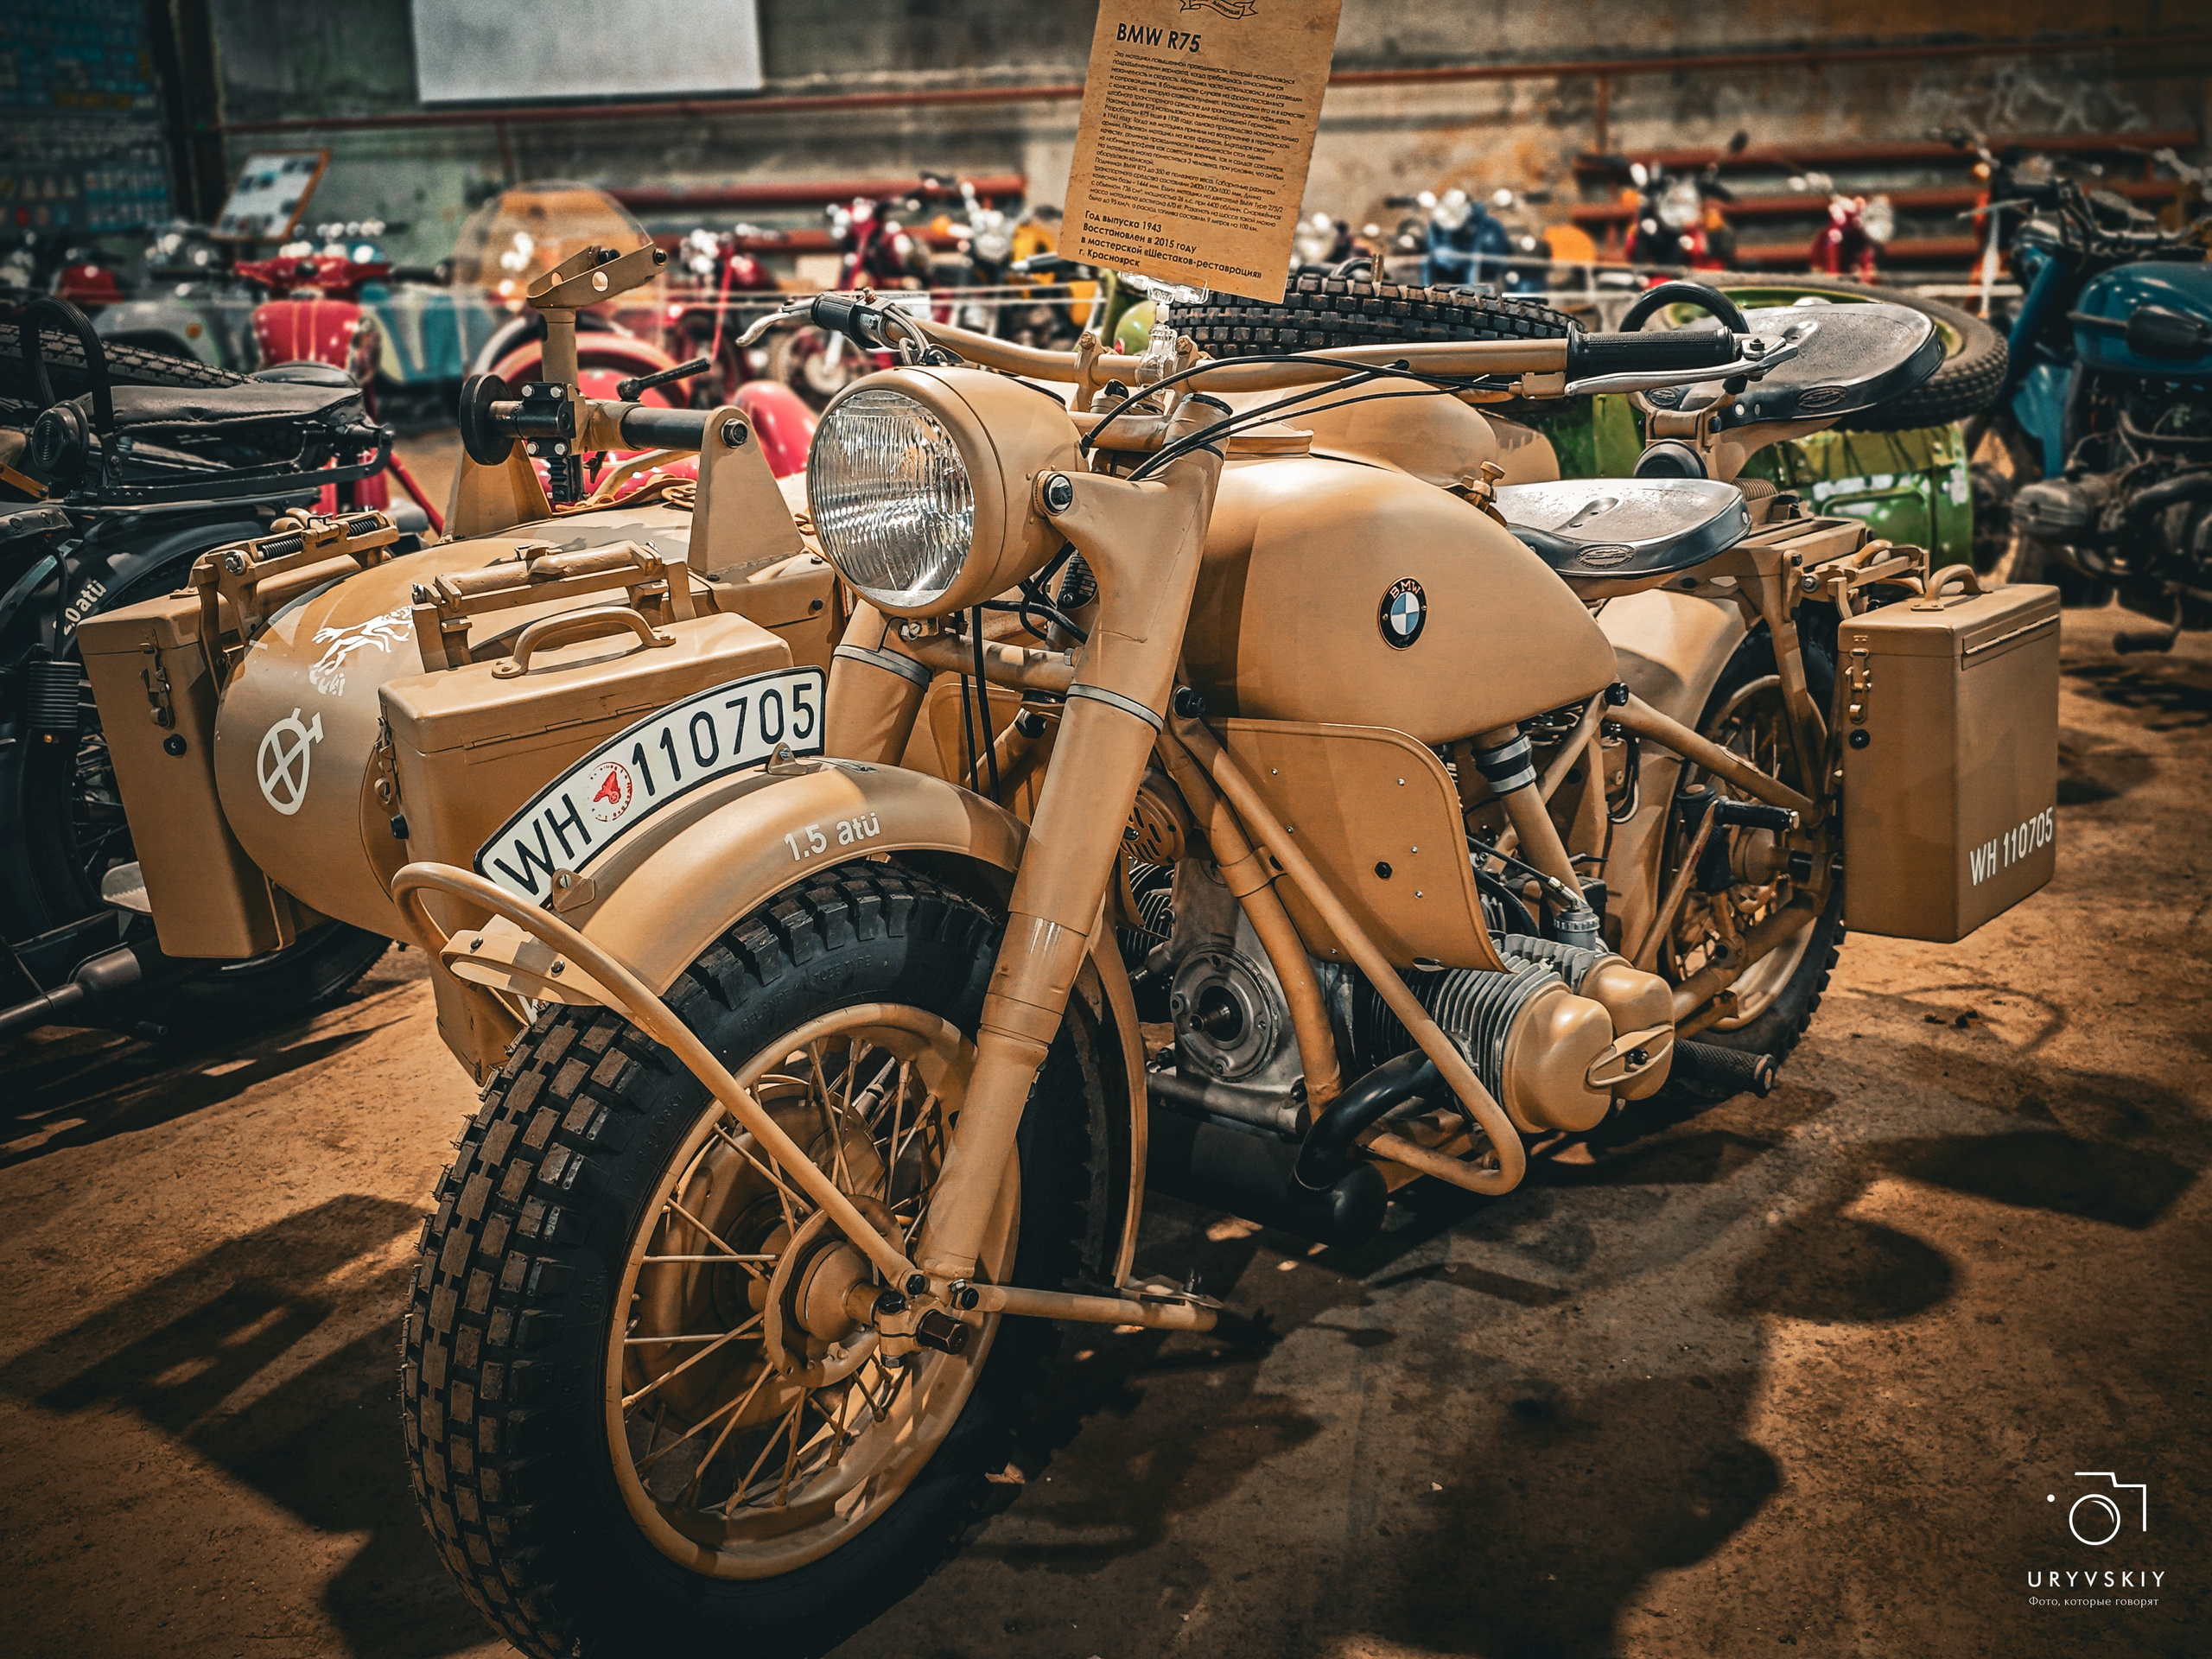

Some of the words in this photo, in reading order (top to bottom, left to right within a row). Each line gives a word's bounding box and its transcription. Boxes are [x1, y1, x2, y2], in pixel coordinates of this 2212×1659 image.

[1116, 22, 1163, 47] BMW
[1167, 30, 1201, 53] R75
[1085, 210, 1100, 221] Год
[1102, 214, 1140, 228] выпуска
[1142, 220, 1161, 232] 1943
[1083, 222, 1145, 243] Восстановлен
[1154, 236, 1174, 248] 2015
[1176, 242, 1197, 254] году
[1087, 248, 1140, 267] Красноярск
[1087, 238, 1142, 255] мастерской
[1144, 248, 1262, 278] «Шестаков-реставрация»
[76, 580, 107, 612] atü
[1389, 580, 1421, 600] BMW
[493, 792, 592, 895] WH
[632, 683, 816, 797] 110705
[785, 823, 828, 861] 1.5
[836, 812, 880, 846] atü
[1970, 838, 1997, 887] WH
[2004, 806, 2053, 868] 110705
